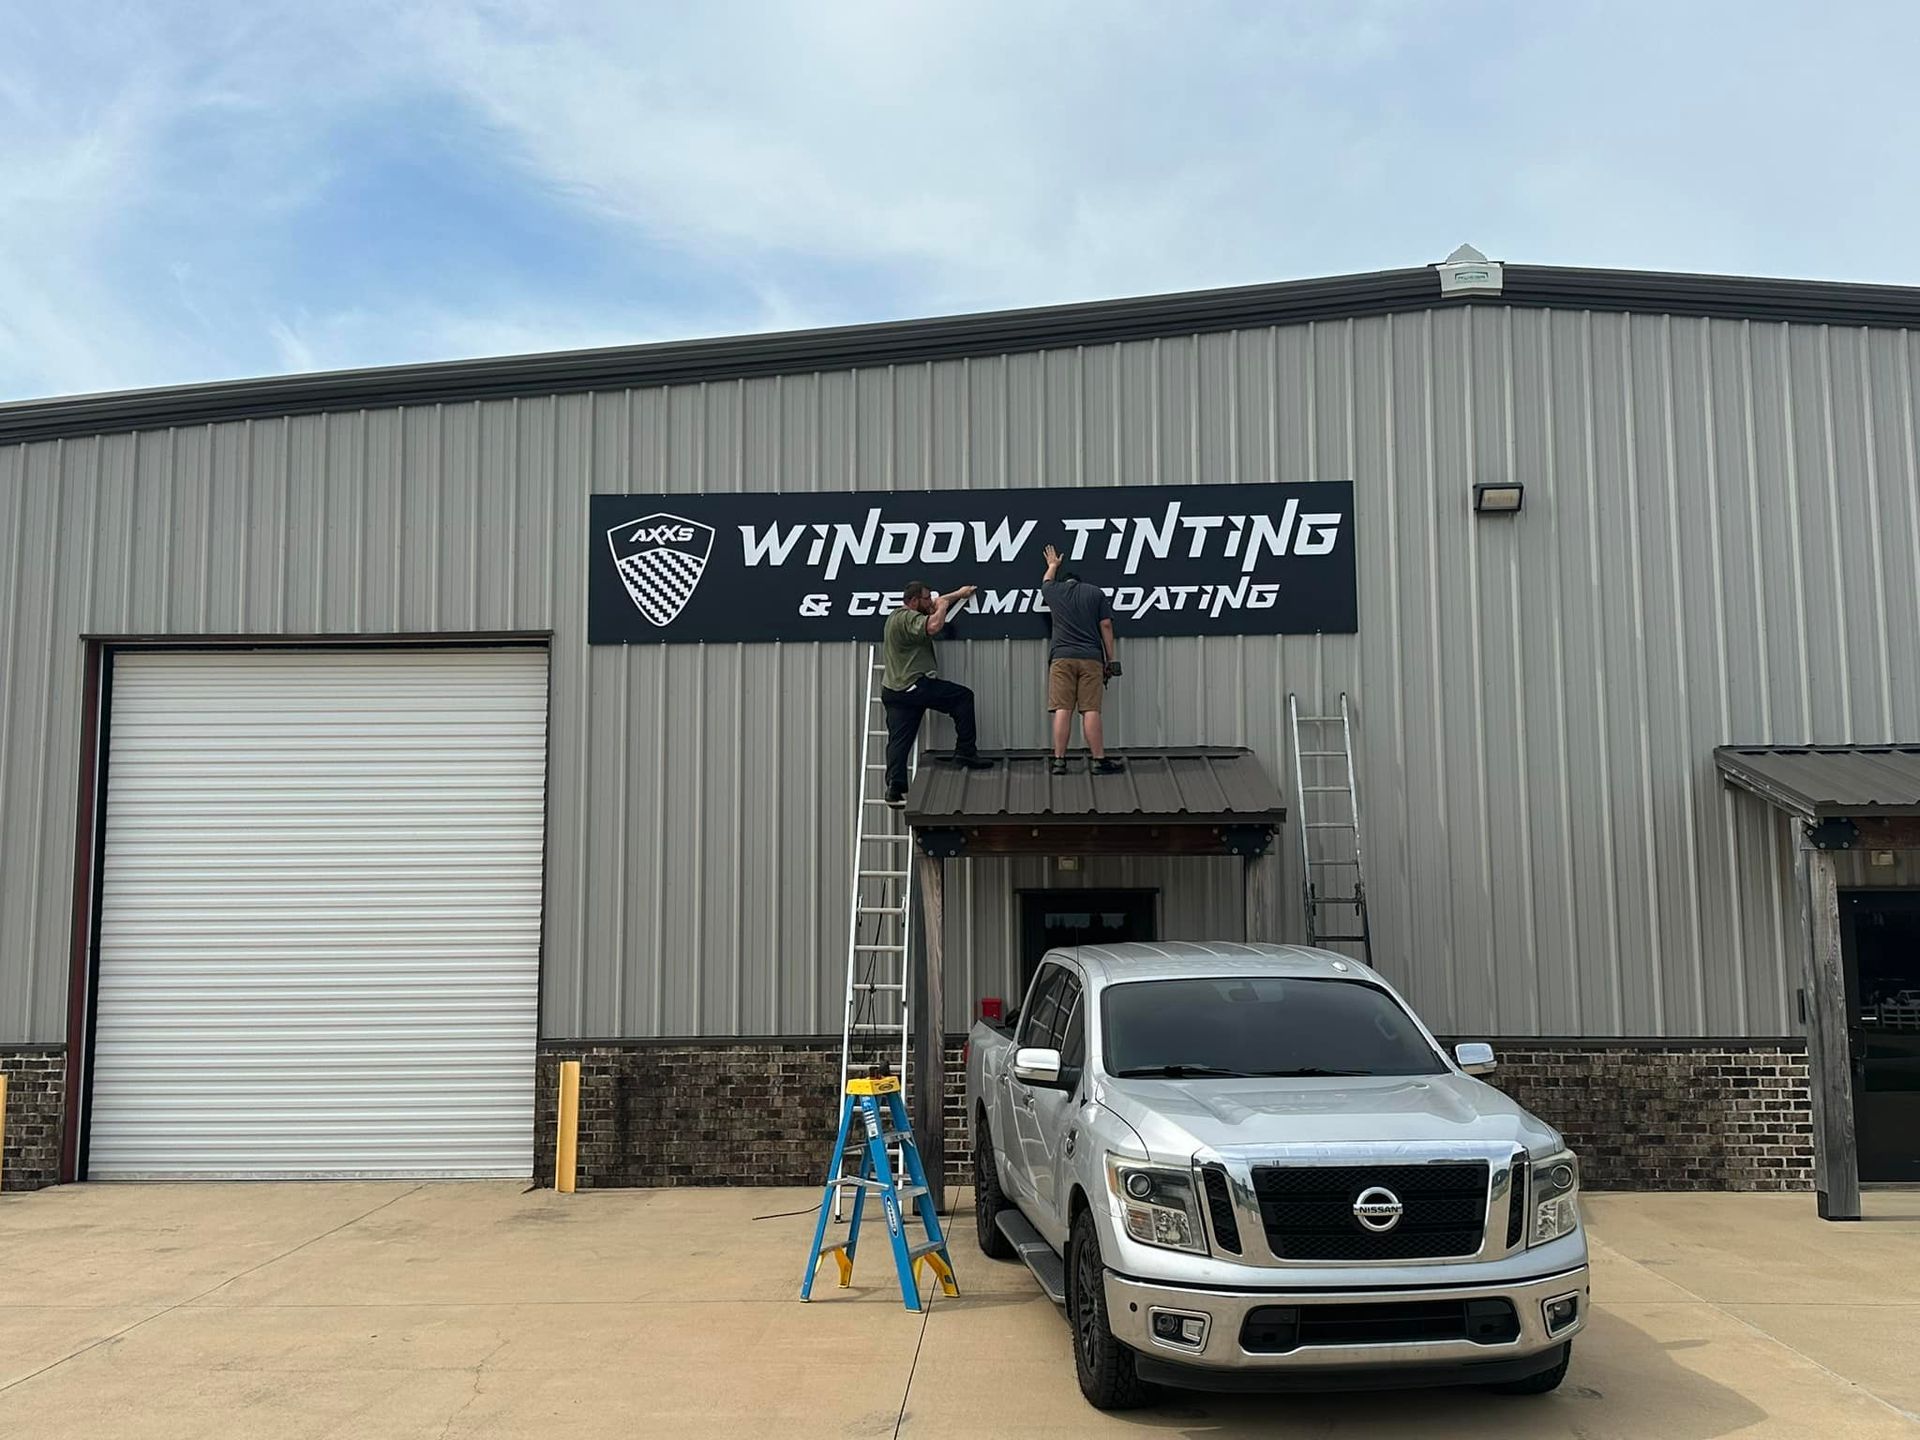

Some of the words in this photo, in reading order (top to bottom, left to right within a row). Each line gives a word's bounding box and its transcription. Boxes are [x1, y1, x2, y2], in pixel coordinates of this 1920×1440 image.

[629, 524, 695, 545] AXXS
[799, 593, 832, 617] &
[1100, 576, 1280, 619] OATING
[1359, 1206, 1399, 1214] NISSAN
